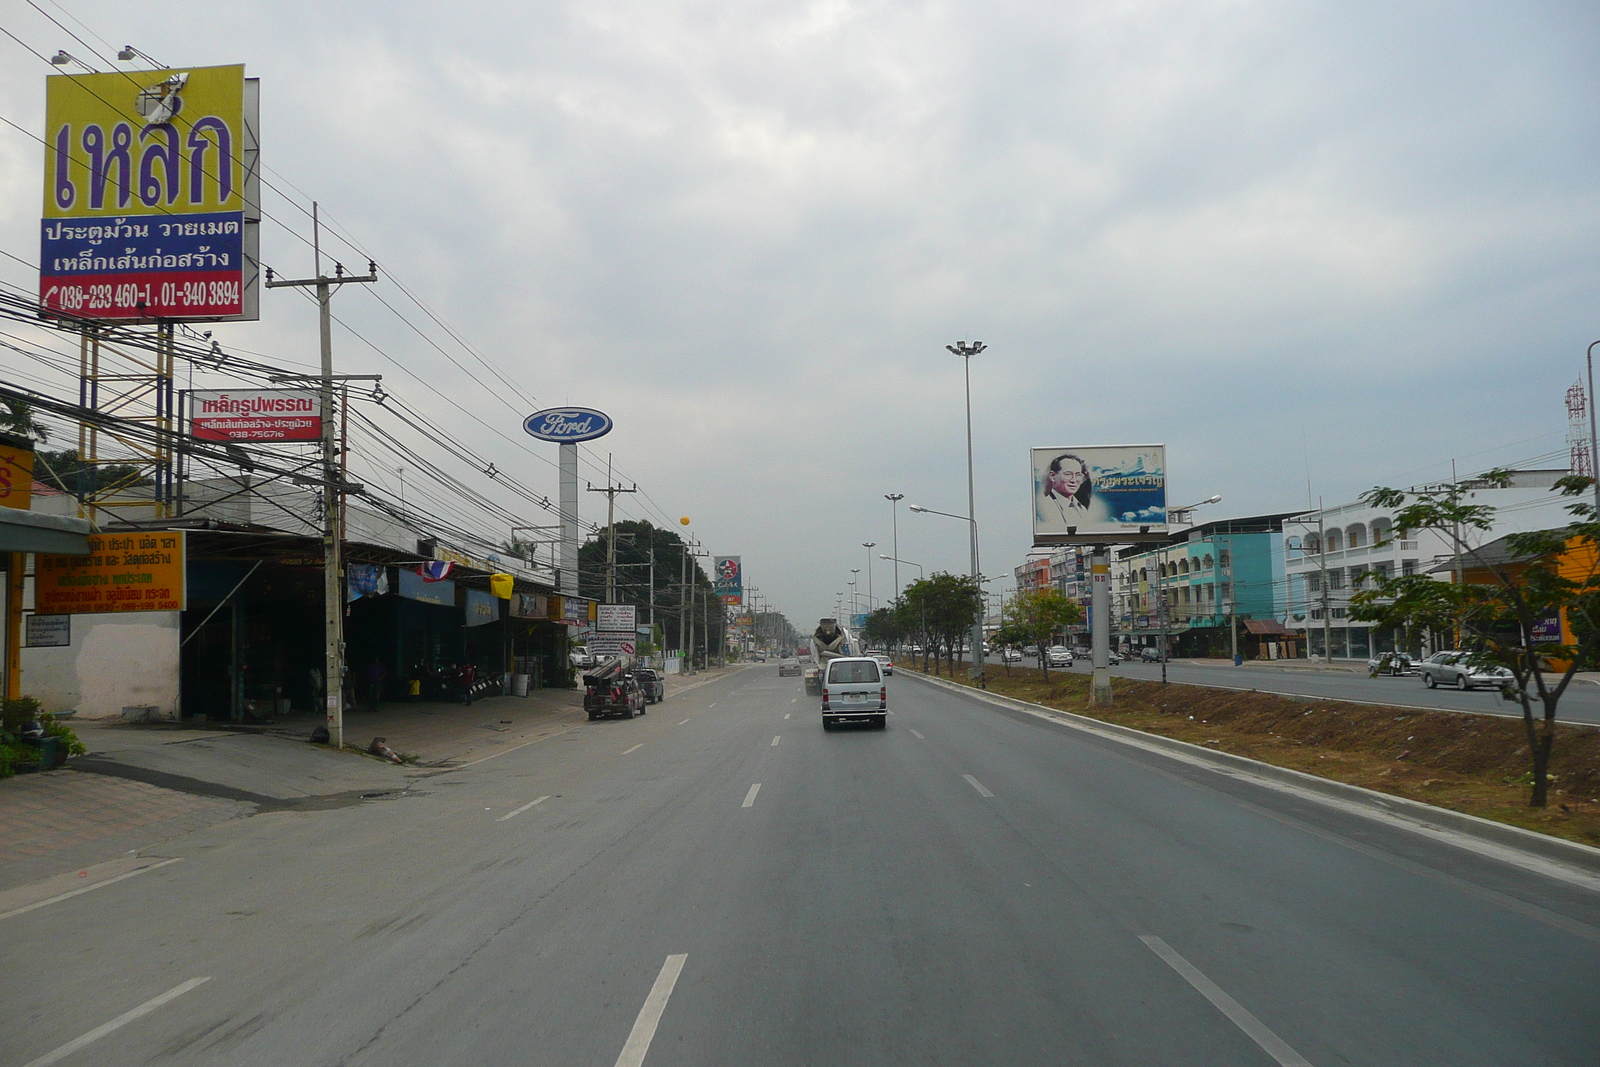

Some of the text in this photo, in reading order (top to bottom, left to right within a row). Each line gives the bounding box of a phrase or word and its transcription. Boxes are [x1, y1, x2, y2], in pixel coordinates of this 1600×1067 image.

[45, 218, 239, 245] ประตูม้วน วายเมต
[54, 246, 229, 271] เหล็กเส้นก่อสร้าง
[60, 284, 112, 310] 038-233
[161, 282, 207, 306] 01-340
[208, 281, 240, 306] 3894
[202, 394, 313, 417] เหล็กรูปพรรณ
[540, 412, 593, 435] Ford
[1091, 473, 1163, 488] ทรงพระเจริญ
[145, 587, 170, 600] กระจก
[157, 600, 178, 610] 5400
